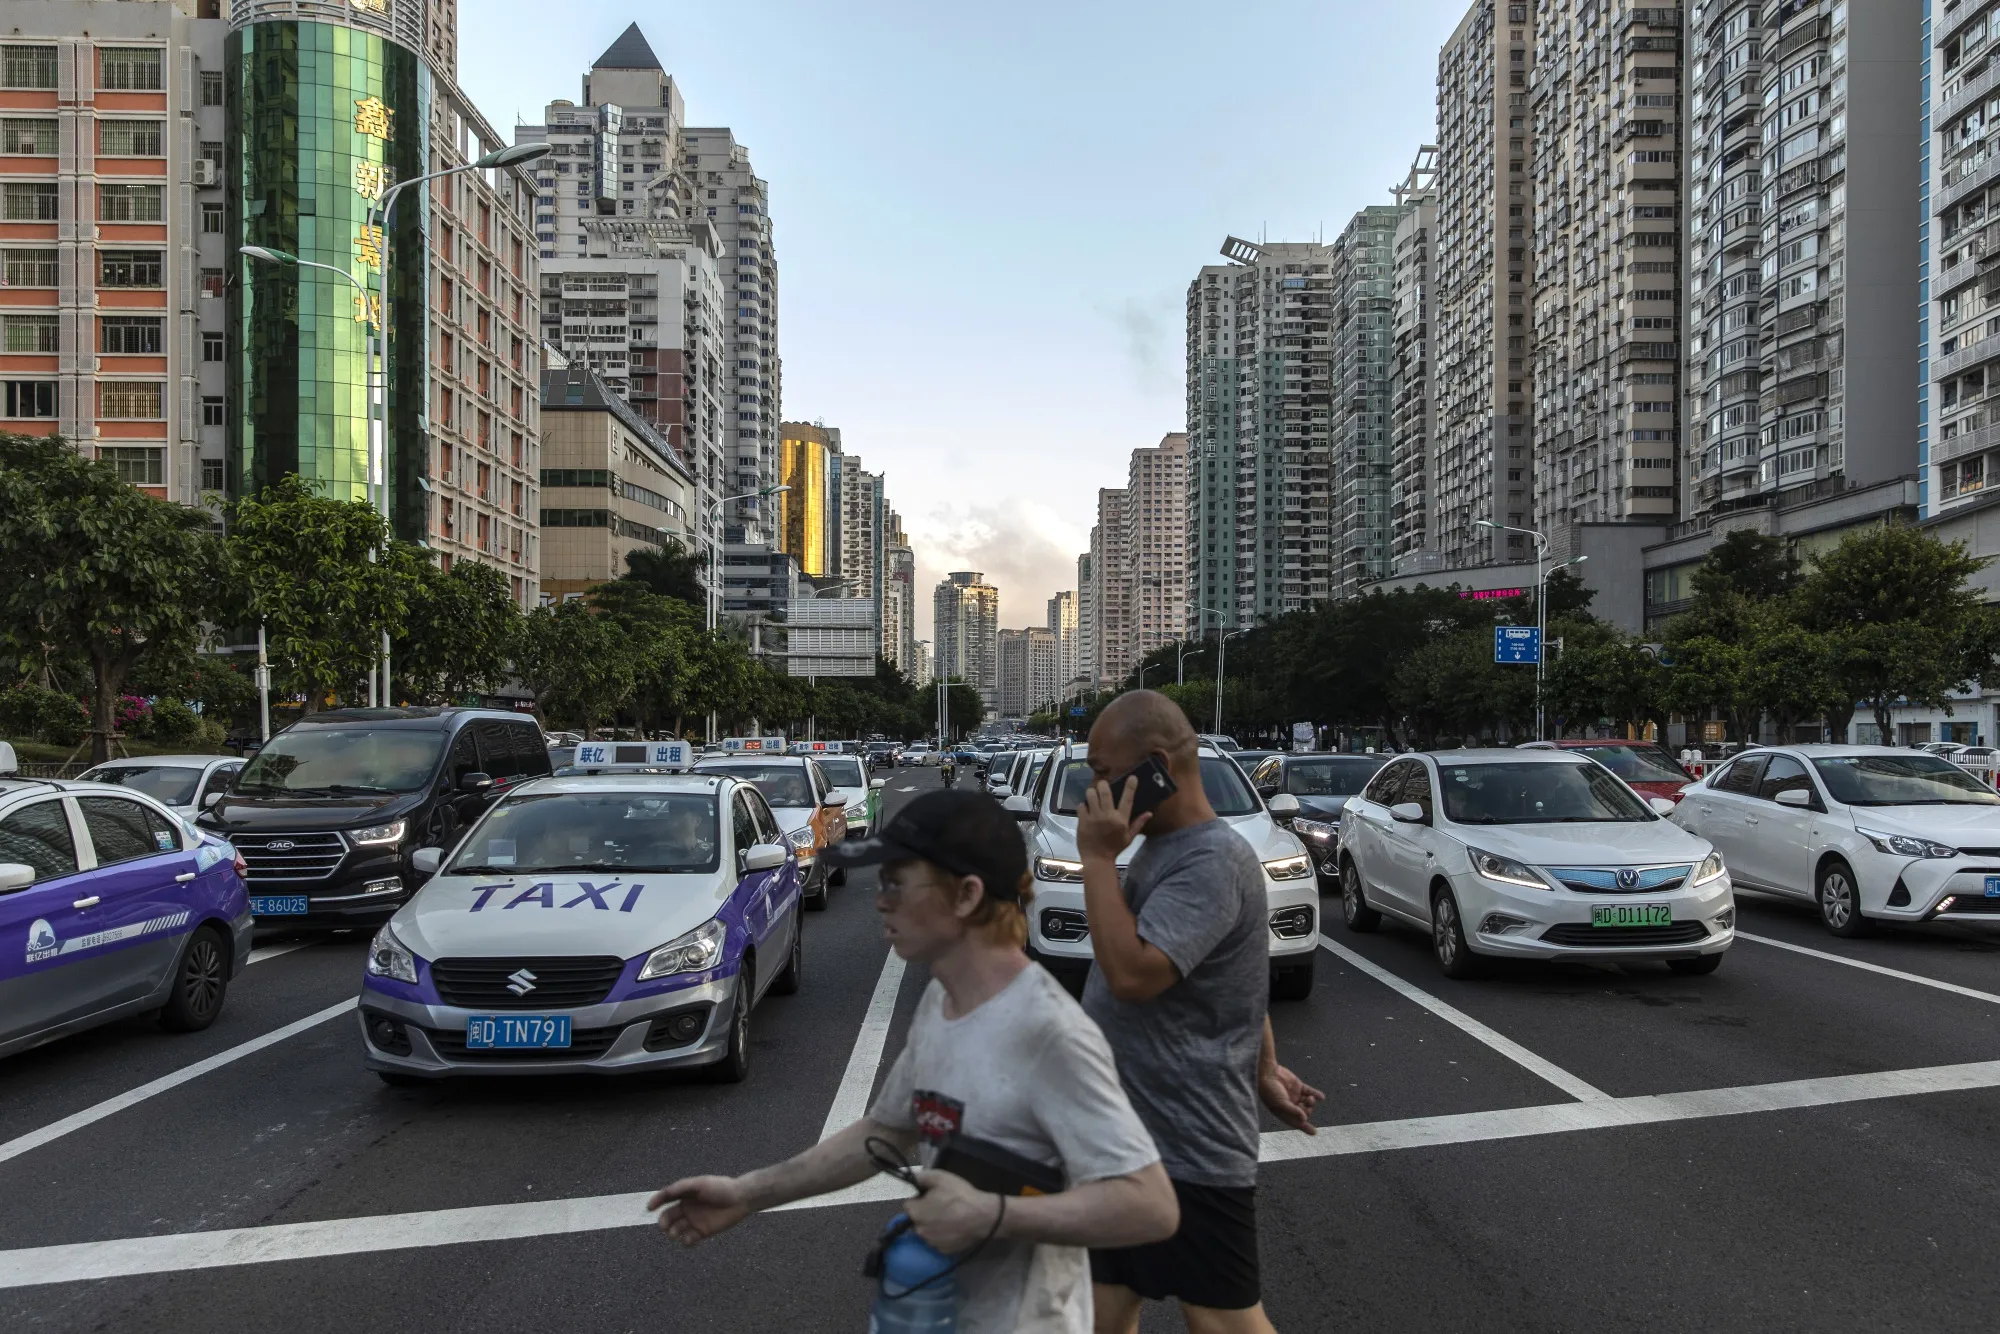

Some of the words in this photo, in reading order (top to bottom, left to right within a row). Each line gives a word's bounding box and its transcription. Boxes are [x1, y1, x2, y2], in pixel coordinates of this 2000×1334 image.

[765, 739, 780, 750] 出租
[579, 746, 605, 764] 联亿
[656, 746, 681, 763] 出租
[469, 882, 645, 913] TAXI
[26, 948, 58, 963] 联亿出租
